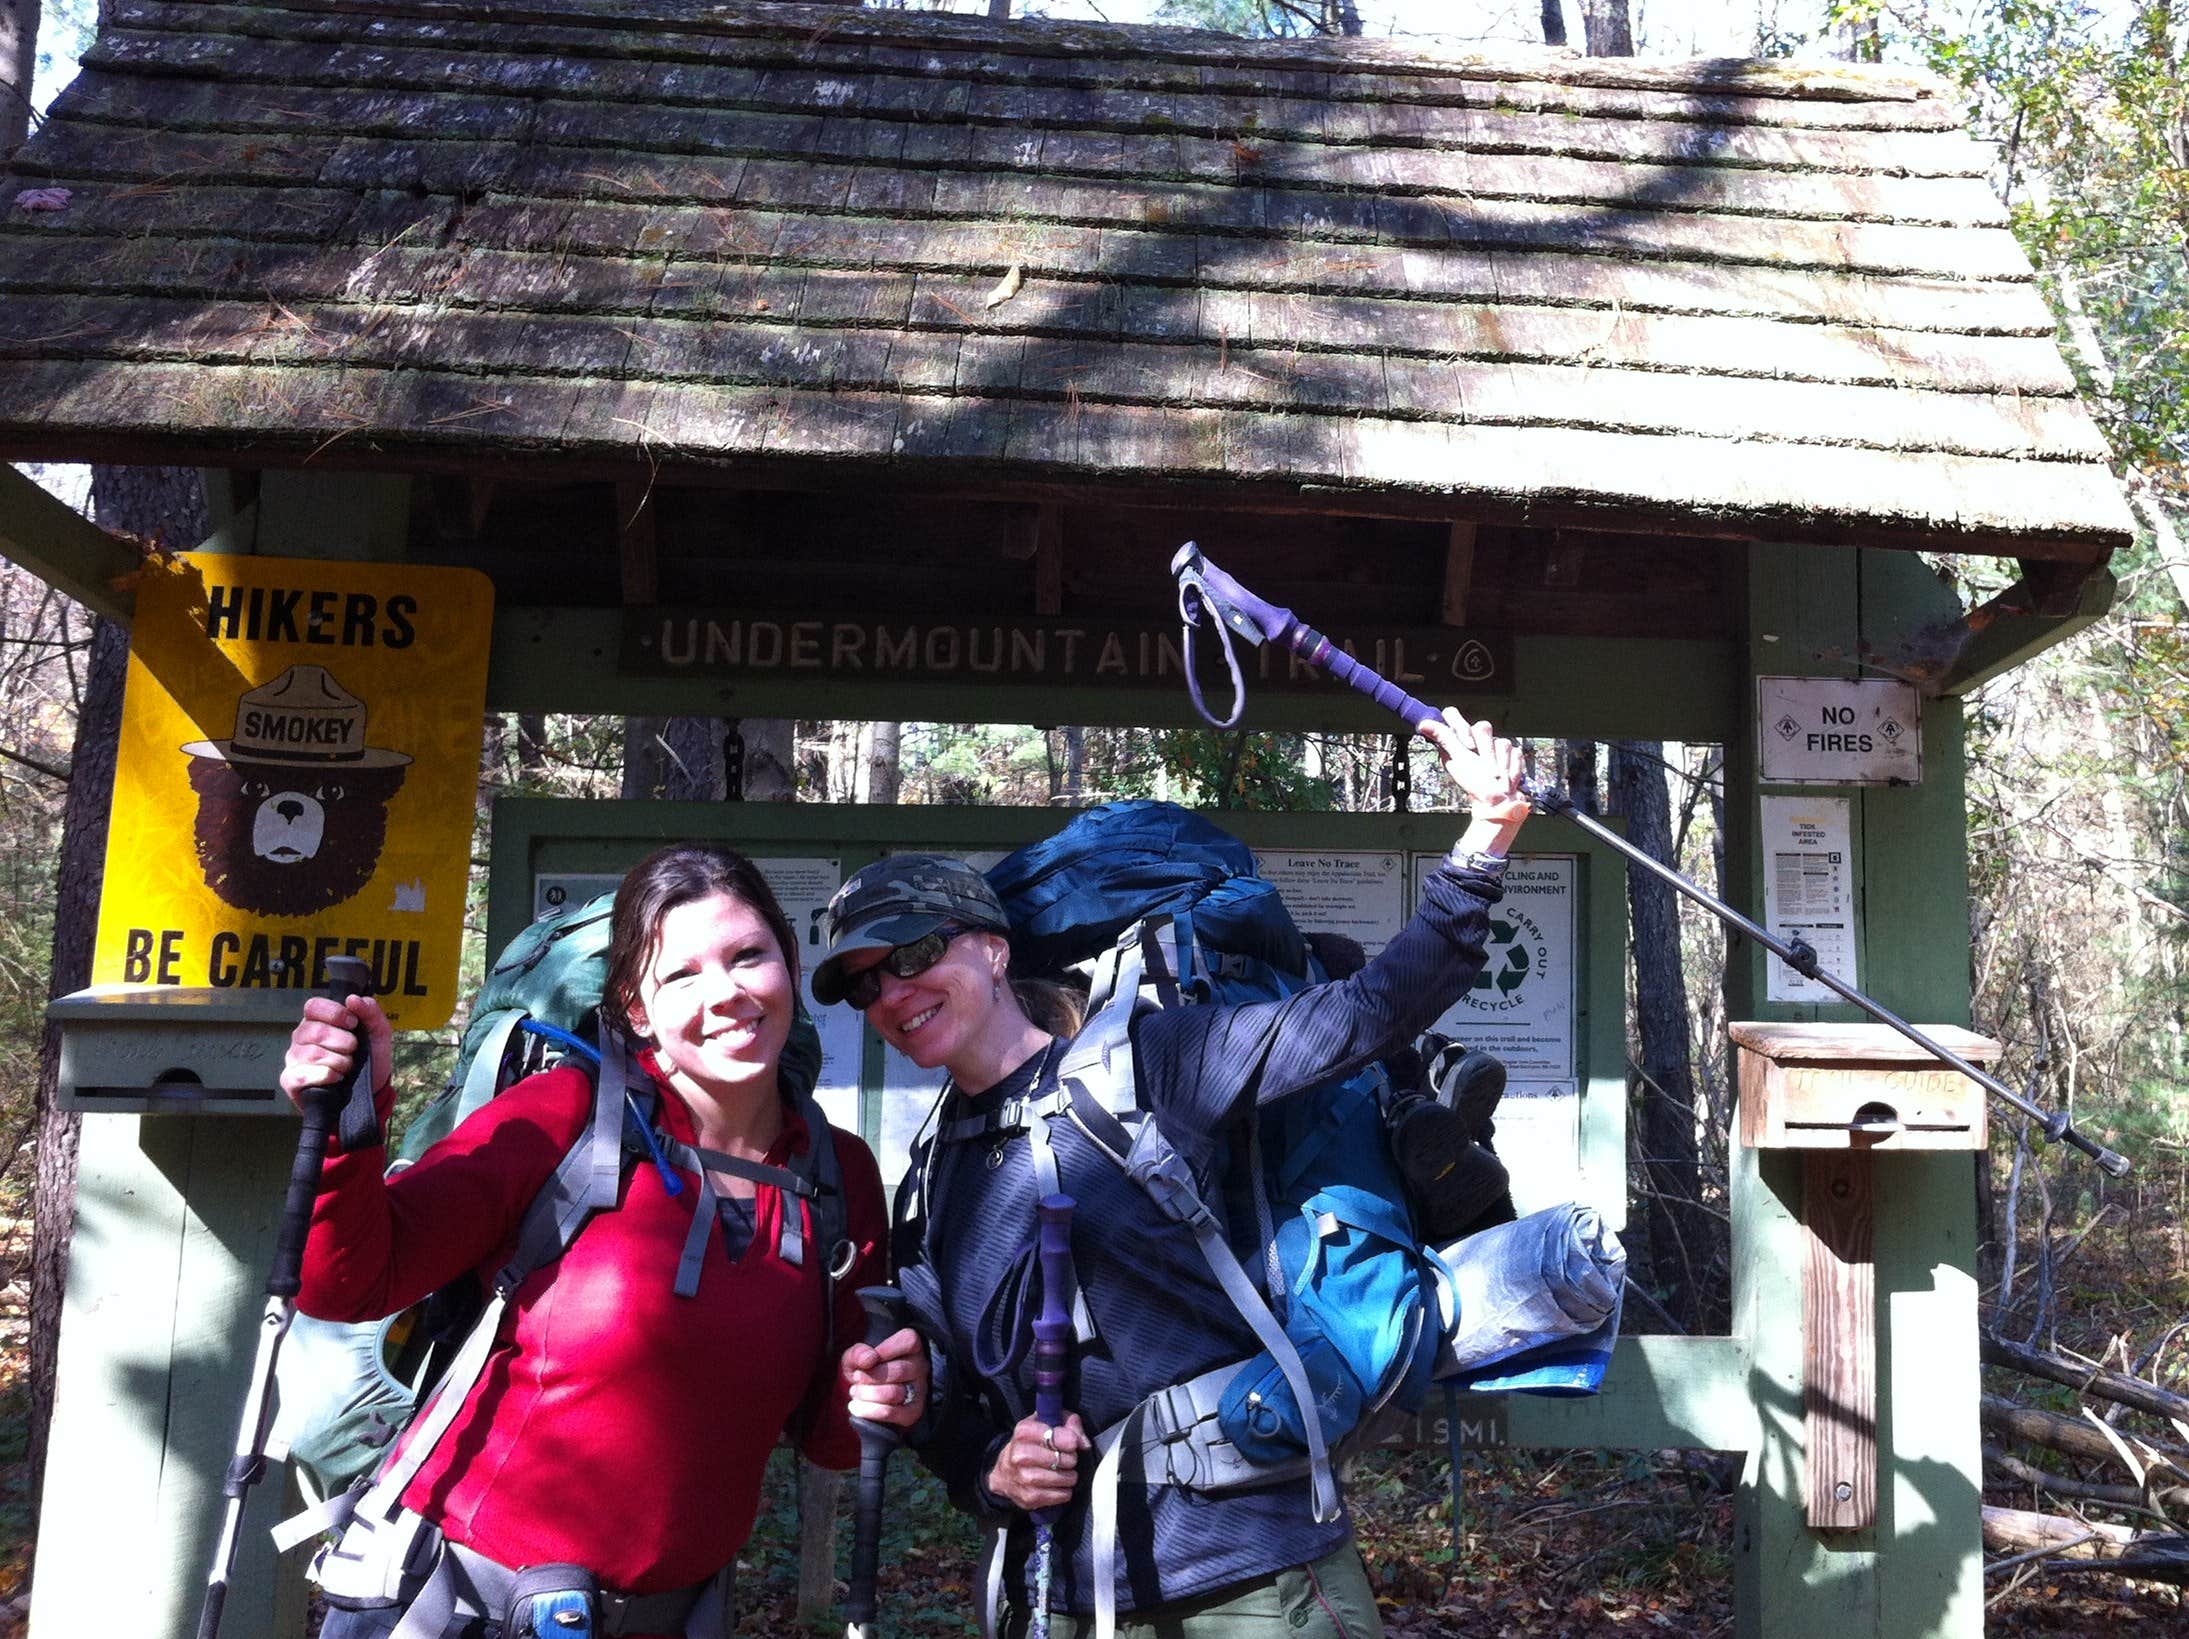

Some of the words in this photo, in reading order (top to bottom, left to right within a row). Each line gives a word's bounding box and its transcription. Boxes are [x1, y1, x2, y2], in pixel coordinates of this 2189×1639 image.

[206, 585, 417, 649] HIKERS
[661, 618, 1188, 678] UNDERMOUNTAIN
[1822, 706, 1856, 725] NO
[244, 711, 354, 744] SMOKEY
[1807, 733, 1873, 752] FIRES
[1288, 858, 1316, 868] Leave
[1318, 859, 1332, 868] No
[1334, 859, 1361, 869] Trace
[1504, 871, 1534, 882] CLING
[1537, 871, 1560, 882] AND
[1503, 884, 1567, 896] NVIRONMENT
[1506, 907, 1545, 941] CARRY
[1536, 946, 1548, 980] OUT
[123, 928, 185, 985] BE
[1461, 993, 1525, 1012] RECYCLE
